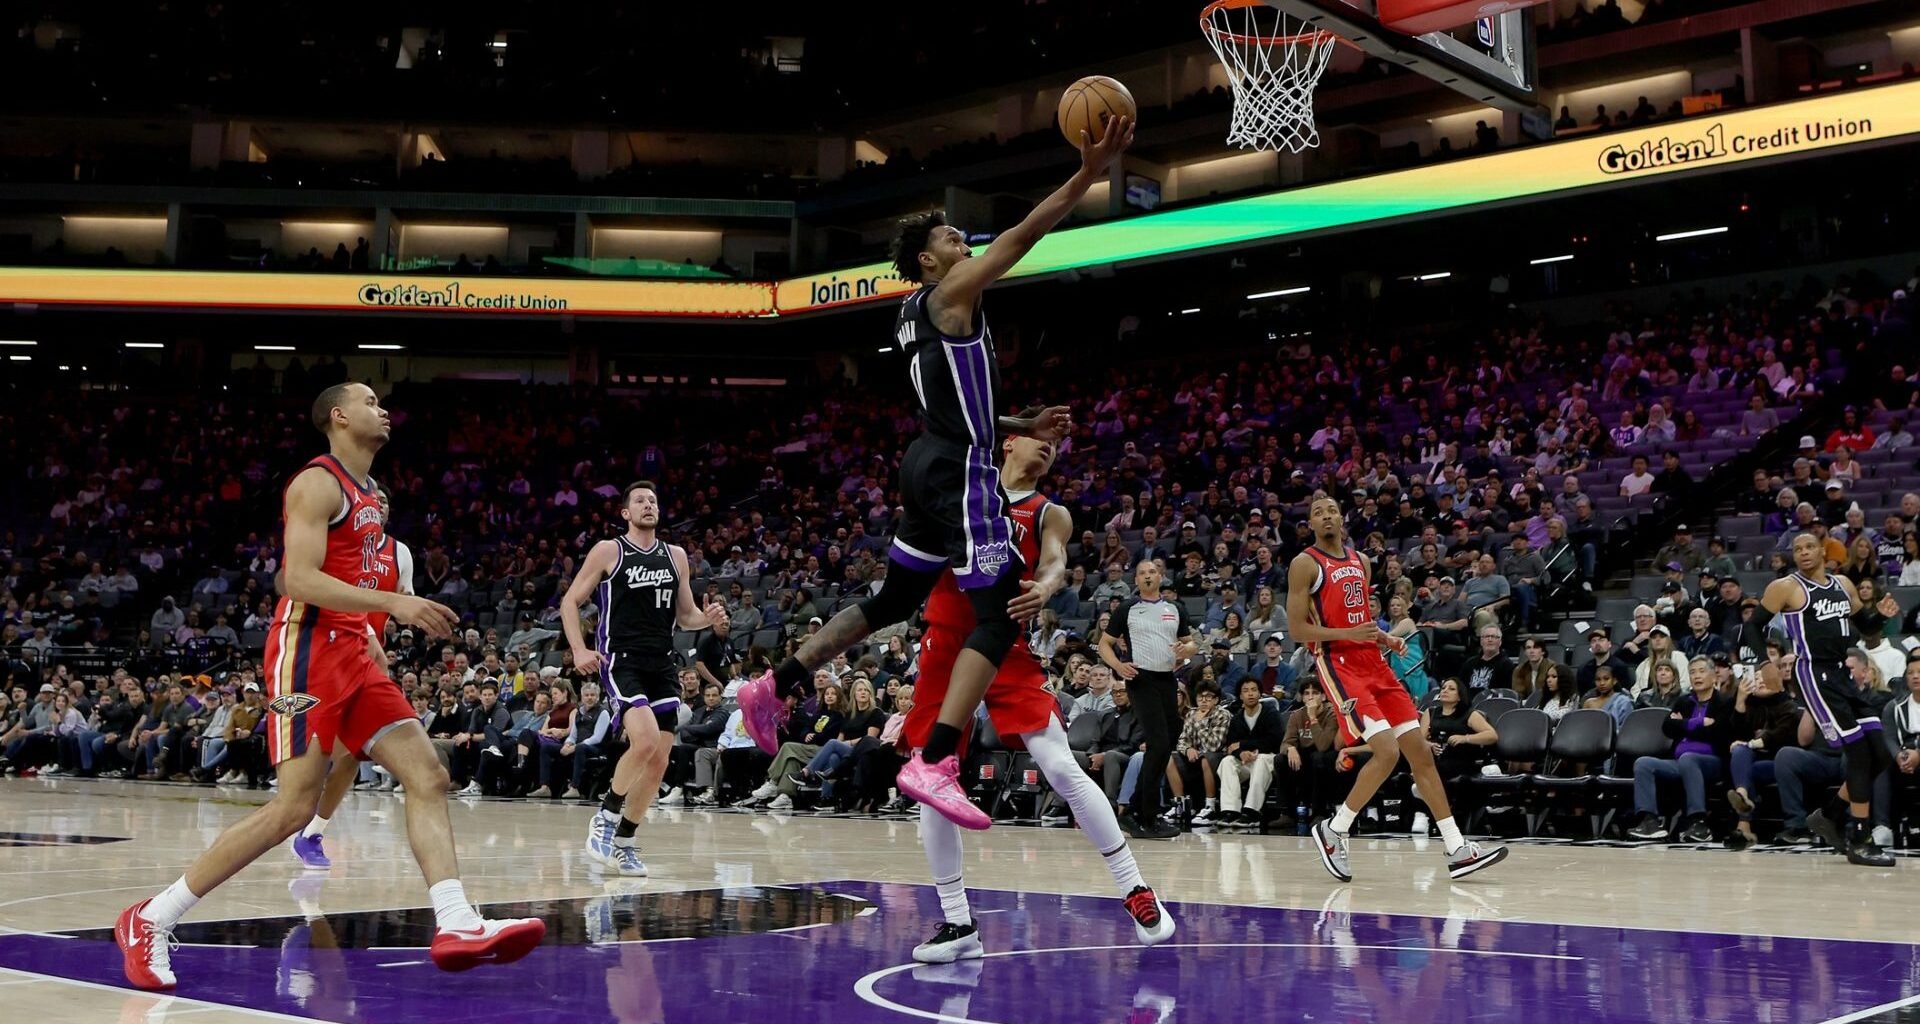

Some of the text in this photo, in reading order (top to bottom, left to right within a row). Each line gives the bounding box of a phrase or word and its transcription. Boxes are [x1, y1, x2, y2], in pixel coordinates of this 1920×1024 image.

[1599, 118, 1872, 174] Golden1 Credit Union
[358, 282, 567, 310] Golden1 Credit Union
[811, 276, 850, 305] Join
[978, 554, 1008, 564] KINGS
[625, 565, 674, 589] Kings
[655, 588, 673, 609] 19
[1343, 580, 1364, 607] 25
[1347, 609, 1365, 624] CITY
[1812, 598, 1851, 622] Kings
